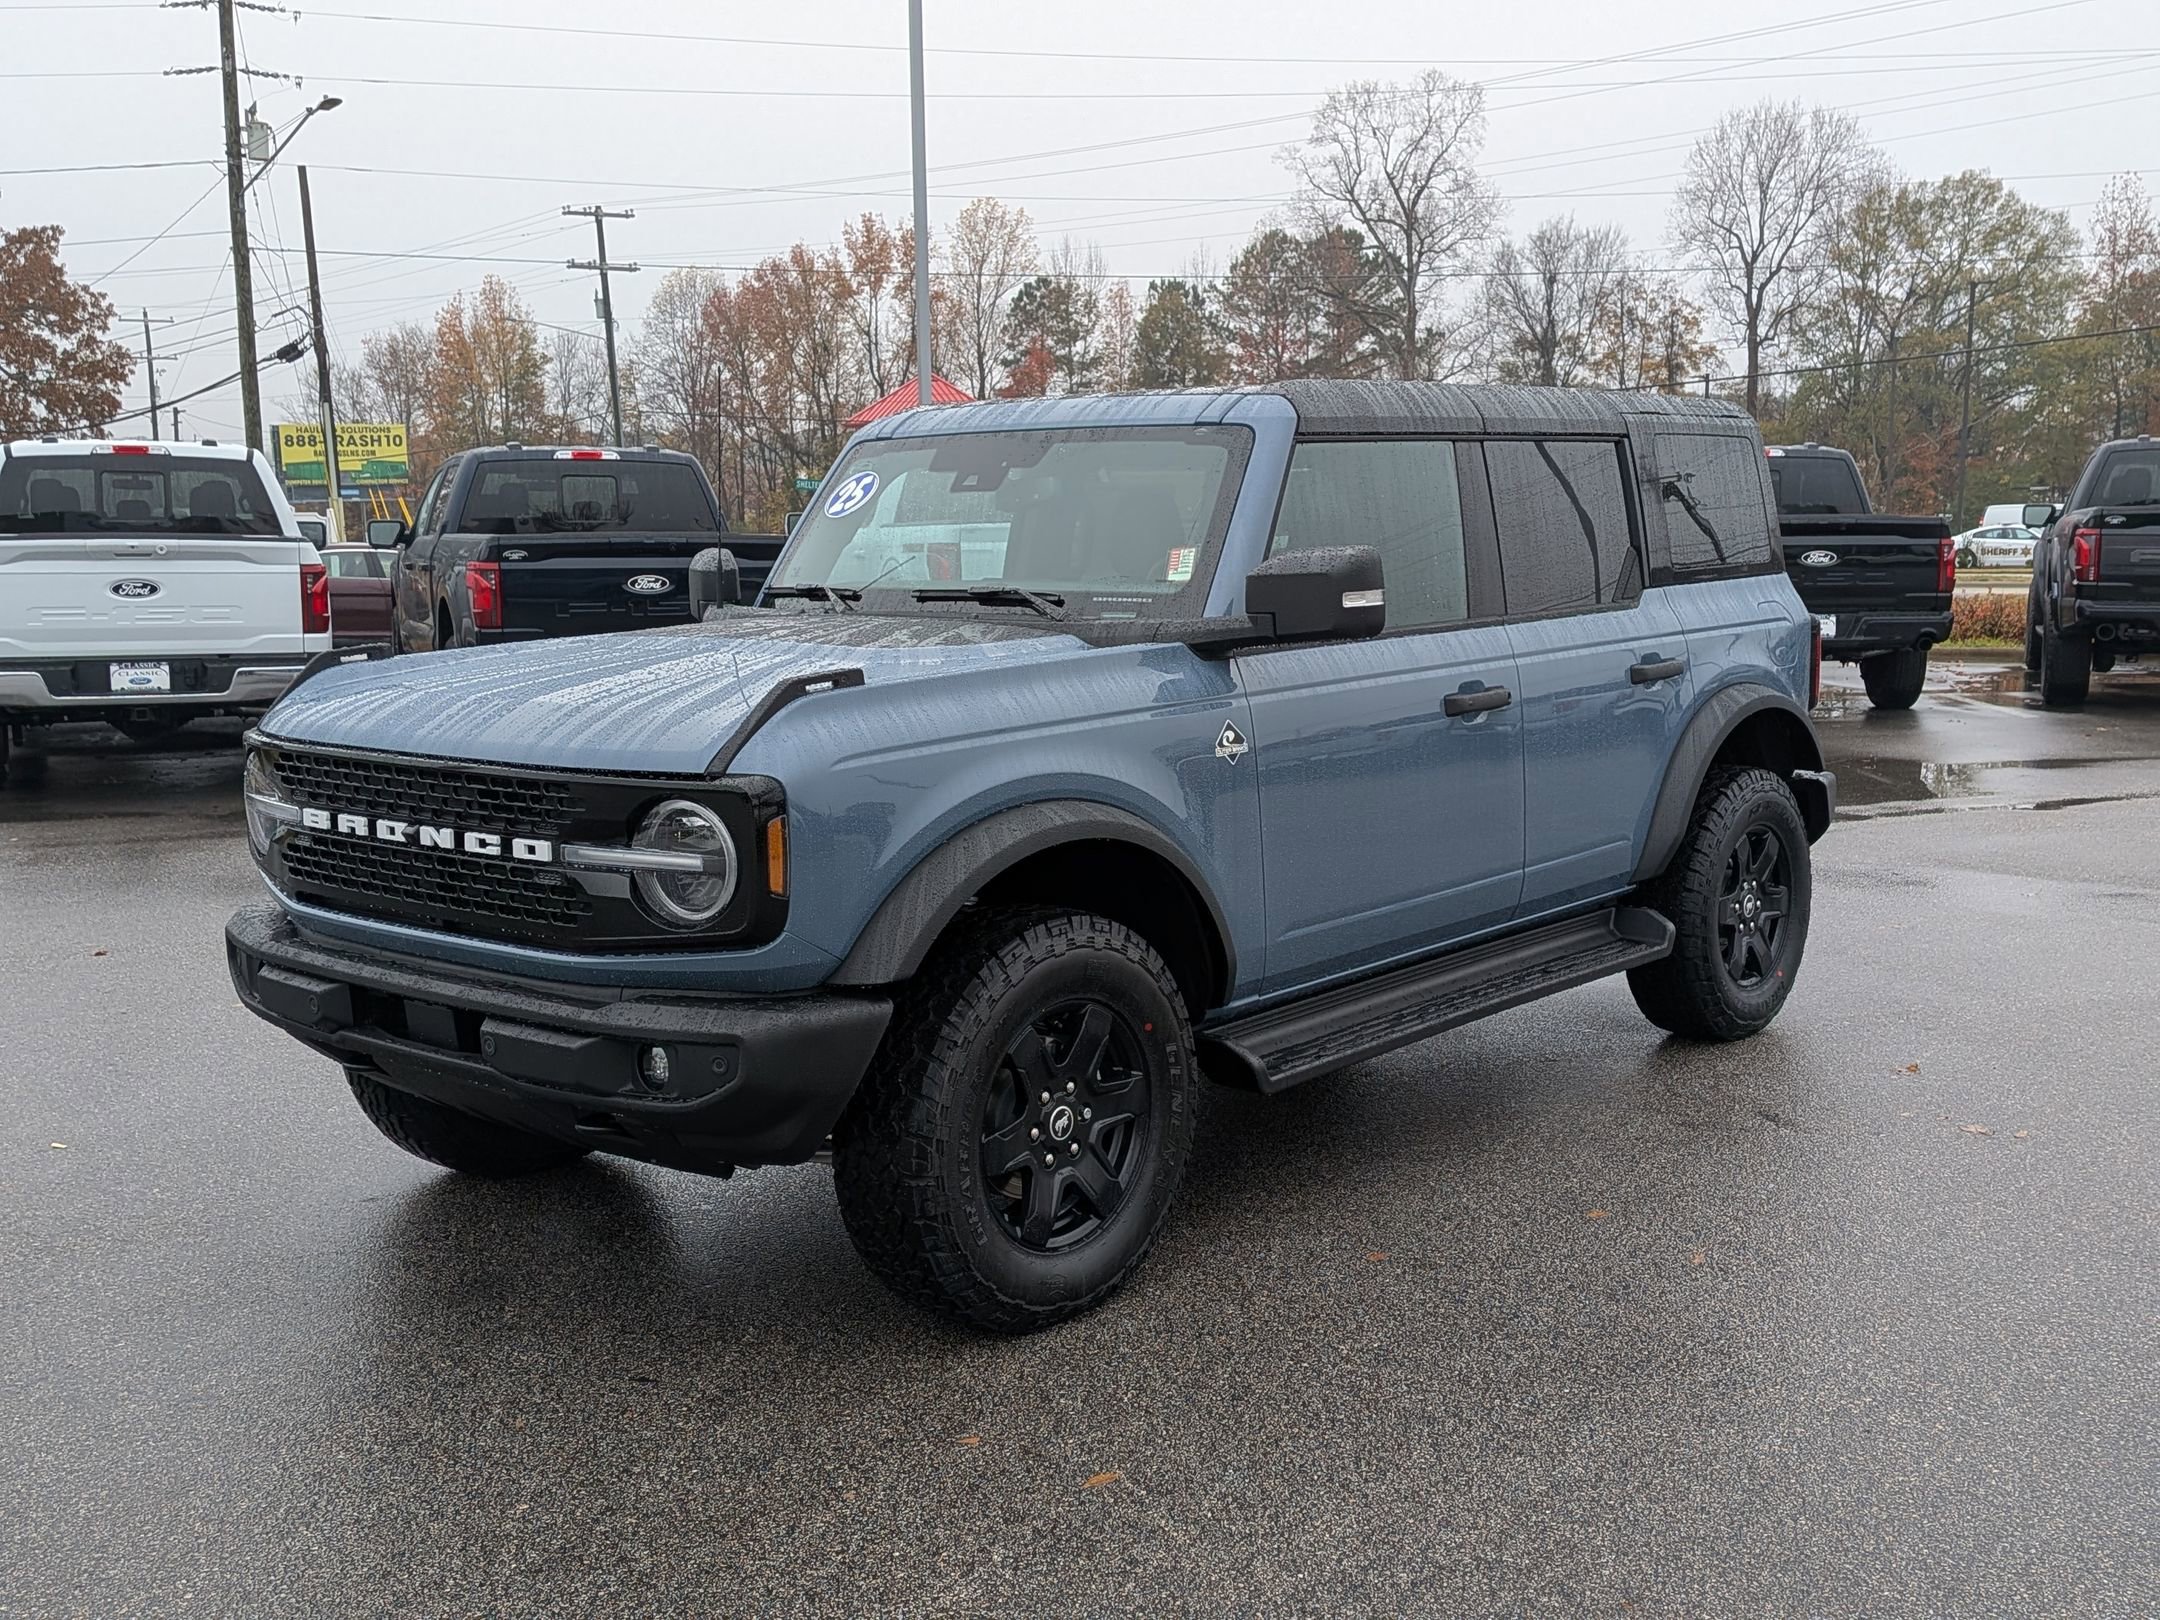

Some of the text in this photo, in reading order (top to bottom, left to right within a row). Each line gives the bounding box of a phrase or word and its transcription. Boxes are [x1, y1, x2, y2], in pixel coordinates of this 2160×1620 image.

[295, 425, 392, 434] HAUL SOLUTIONS
[284, 434, 403, 448] 888-RASH10
[796, 480, 821, 489] SHELTE
[828, 475, 874, 514] 25
[1807, 552, 1831, 563] Ford
[1980, 547, 2019, 556] SHERIFF
[118, 582, 151, 596] Ford
[634, 577, 662, 590] Ford
[302, 807, 553, 862] BRONCO
